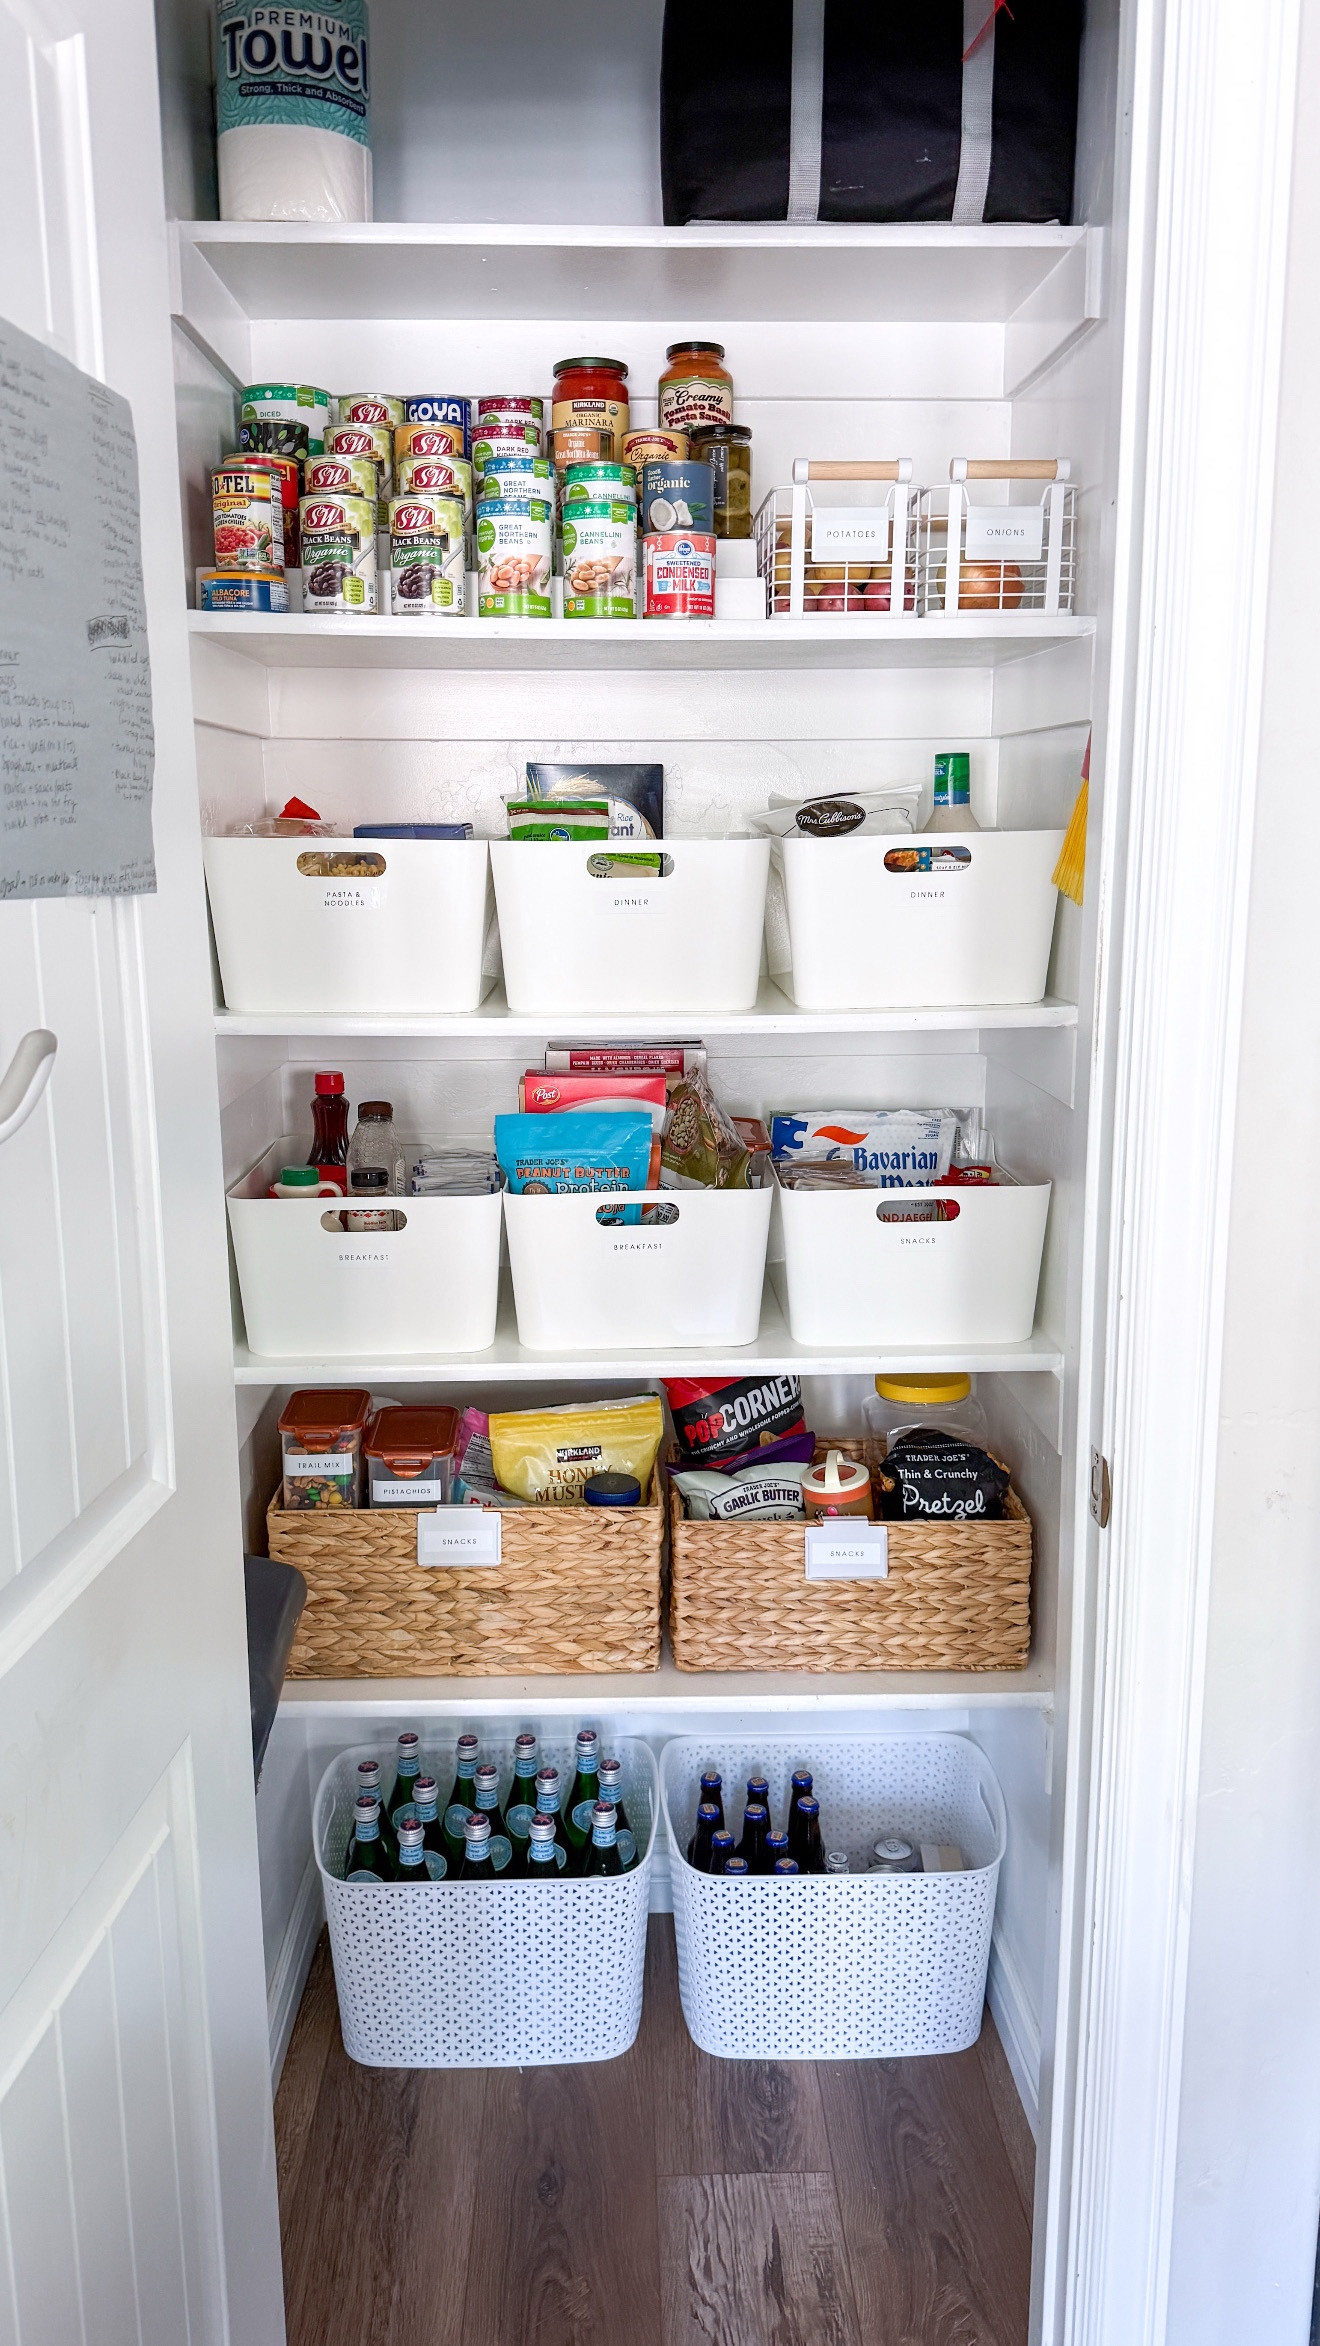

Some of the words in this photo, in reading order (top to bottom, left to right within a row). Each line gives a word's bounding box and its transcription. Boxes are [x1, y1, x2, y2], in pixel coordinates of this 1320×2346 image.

[255, 11, 350, 41] PREMIUM
[222, 20, 367, 93] Towel
[241, 84, 274, 94] Strong,
[277, 83, 302, 93] Thick
[305, 86, 323, 97] and
[325, 91, 364, 114] Absorbent
[574, 401, 605, 409] KIRKLAND
[675, 390, 724, 406] Creamy
[408, 402, 462, 422] GOYA
[664, 402, 706, 420] Tomato
[708, 403, 731, 421] Basil
[565, 418, 614, 427] MARINARA
[667, 413, 697, 427] Pasta
[631, 448, 669, 465] Organic
[648, 476, 690, 494] organic
[826, 530, 876, 538] POTATOES
[986, 528, 1026, 537] ONIONS
[304, 545, 349, 564] Organic
[393, 547, 438, 566] Organic
[656, 568, 709, 580] CONDENSED
[212, 588, 250, 598] ALBACORE
[672, 580, 697, 592] MILK
[818, 812, 862, 825] Cubbison's
[610, 824, 634, 837] ant
[536, 1088, 557, 1100] Post
[516, 1158, 543, 1166] TRADER
[854, 1145, 938, 1172] Bavarian
[516, 1167, 572, 1180] PEANUT
[574, 1166, 630, 1179] BUTTER
[556, 1178, 629, 1194] protein
[684, 1376, 801, 1447] POPCORNER
[700, 1440, 725, 1454] CRUNCHY
[726, 1434, 738, 1445] AND
[739, 1418, 772, 1438] WHOLESOME
[905, 1454, 940, 1462] TRADER
[942, 1454, 967, 1462] JOE'S
[898, 1469, 921, 1479] Thin
[924, 1470, 932, 1479] &
[934, 1468, 978, 1481] Crunchy
[534, 1485, 585, 1502] MUST
[743, 1484, 762, 1492] TRADER
[723, 1490, 761, 1513] GARLIC
[762, 1489, 800, 1502] BUTTER
[902, 1484, 986, 1520] Pretzel
